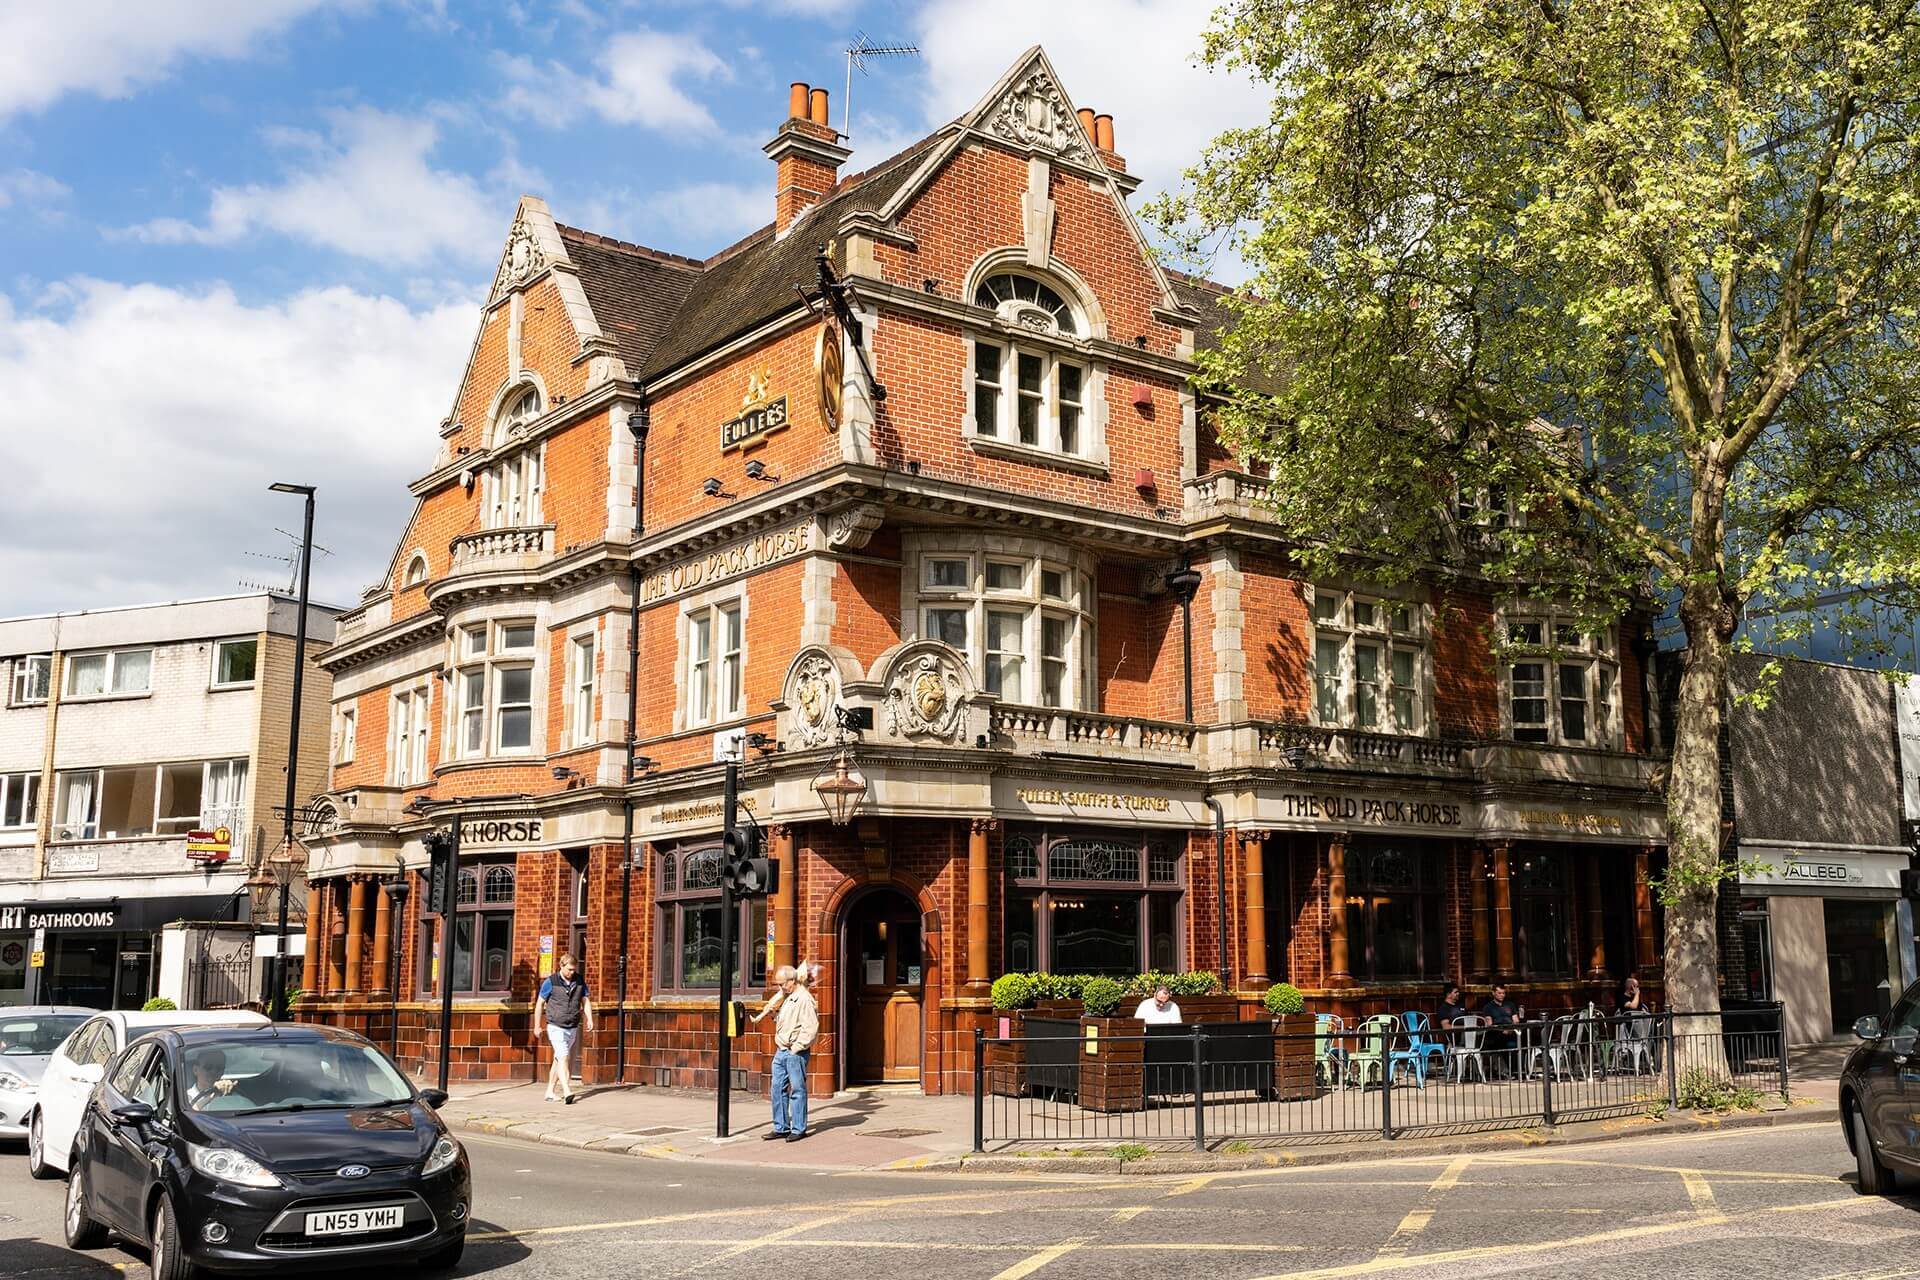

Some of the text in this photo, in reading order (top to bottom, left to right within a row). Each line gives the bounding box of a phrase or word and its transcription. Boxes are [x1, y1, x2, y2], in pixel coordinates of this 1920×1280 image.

[724, 403, 785, 445] FULLER'S
[706, 543, 750, 582] PACK
[1016, 788, 1065, 805] FULLER
[1067, 791, 1108, 809] SMITH
[1123, 794, 1171, 812] TURNER
[1283, 794, 1462, 825] THE OLD PACK HORSE
[473, 821, 542, 843] HORSE
[0, 907, 114, 929] RT BATHROOMS
[345, 1166, 364, 1176] Ford
[313, 1208, 397, 1232] LN59 YMH
